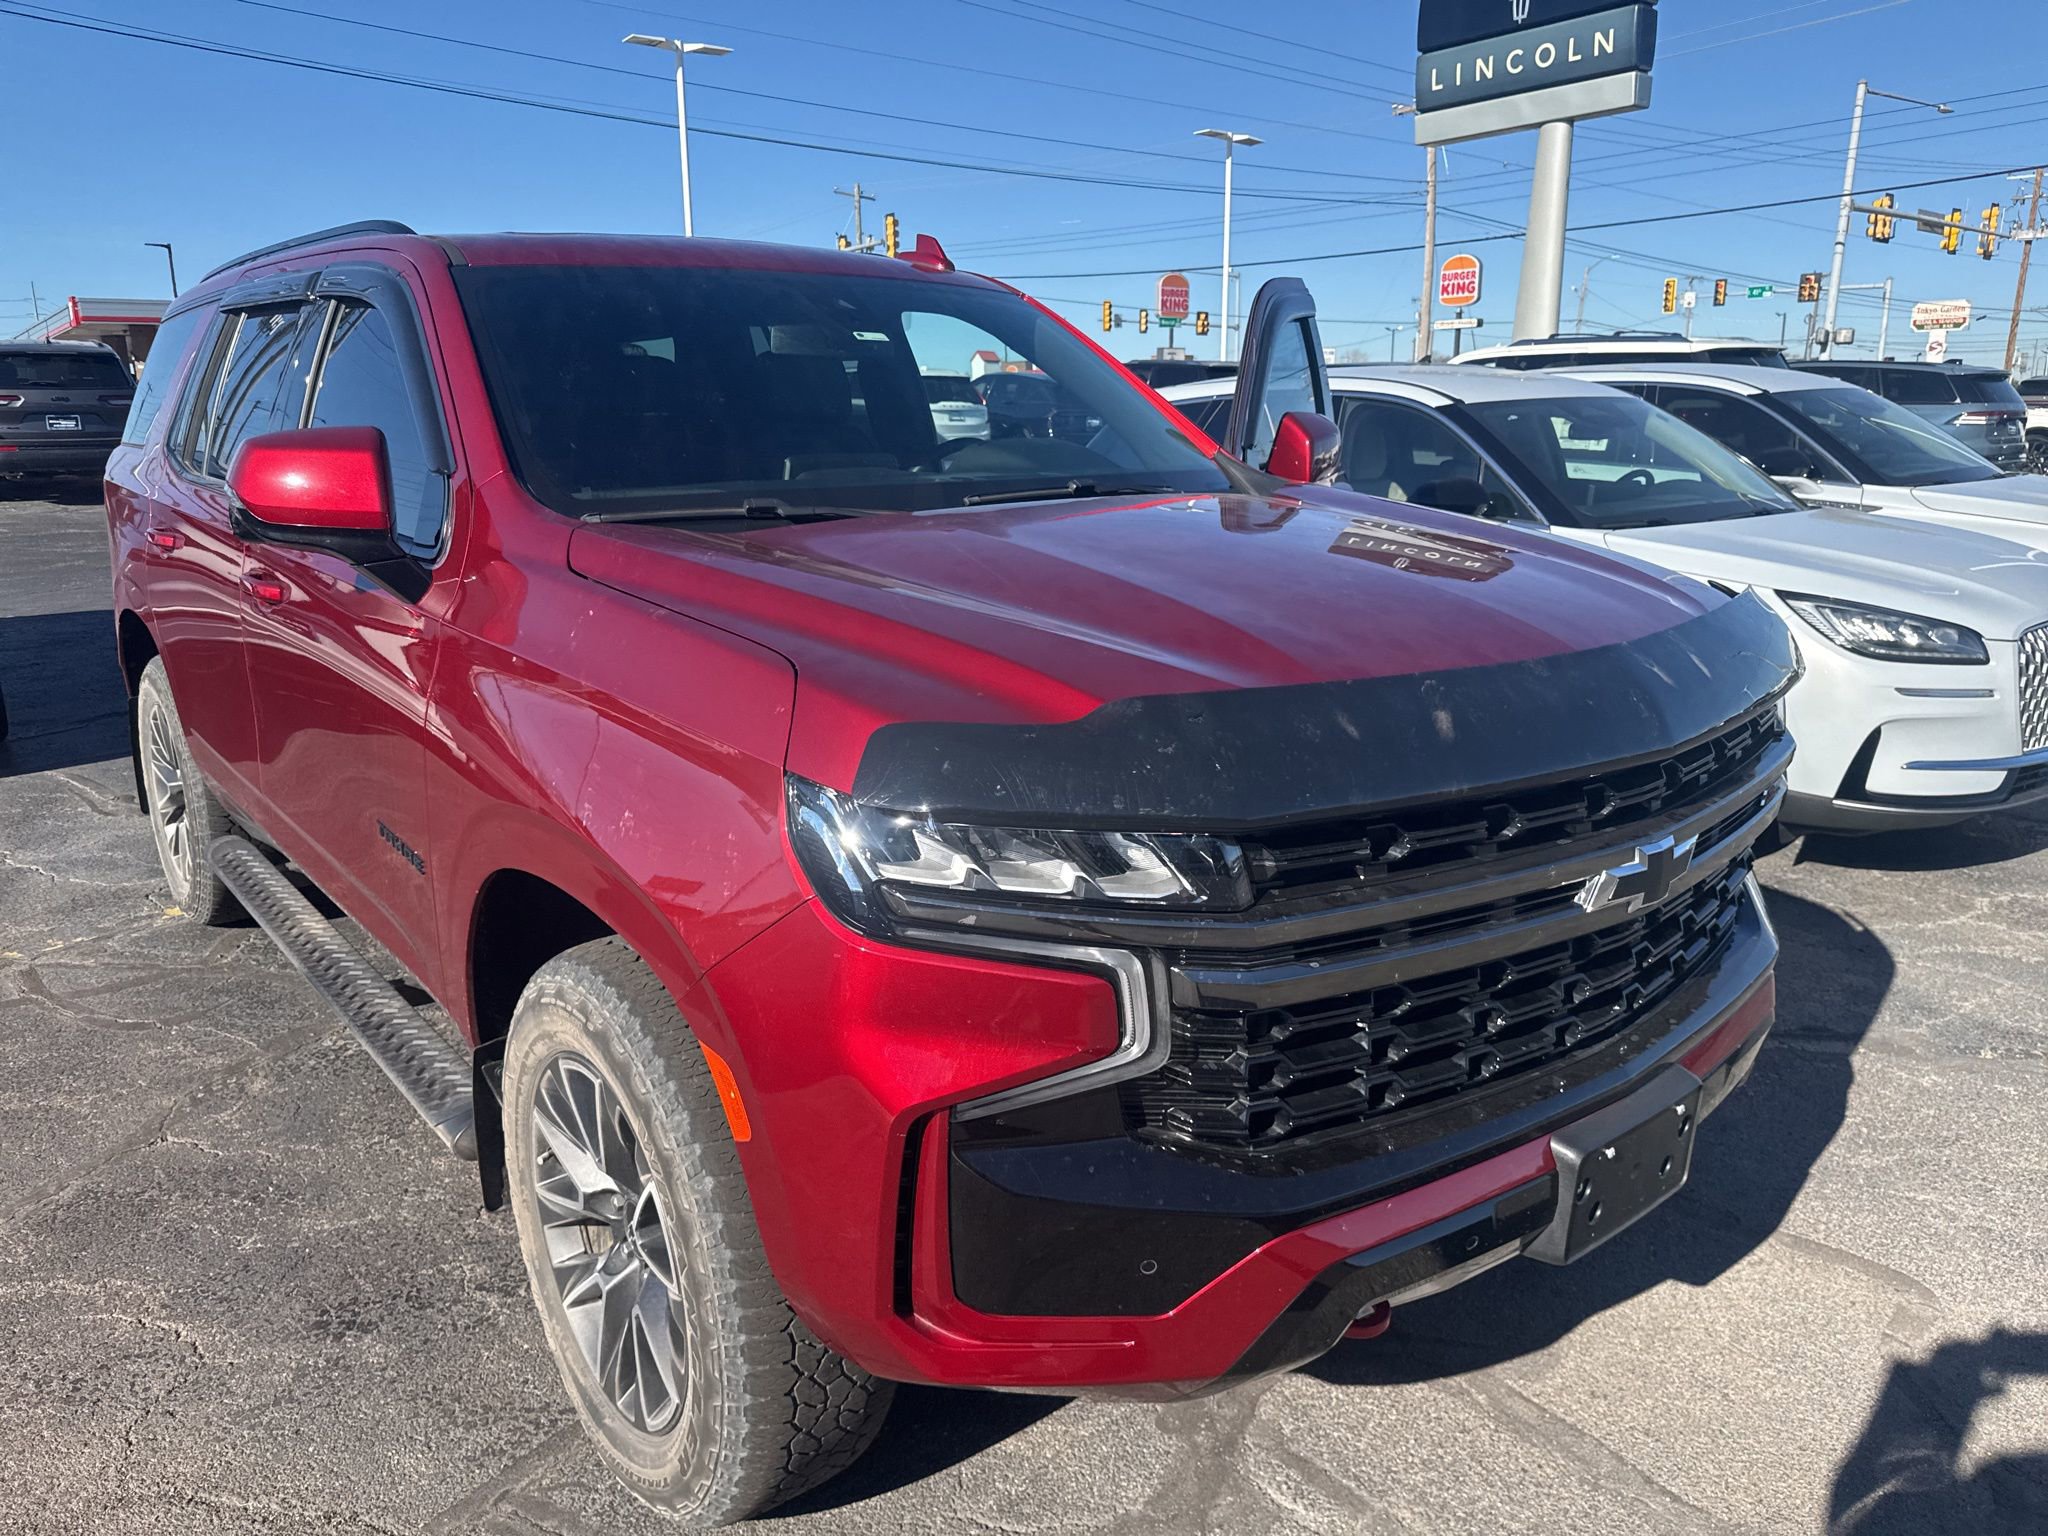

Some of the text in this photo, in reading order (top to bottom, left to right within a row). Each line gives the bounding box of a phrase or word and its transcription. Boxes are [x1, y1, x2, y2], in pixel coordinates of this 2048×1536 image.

[1431, 28, 1615, 91] LINCOLN
[1441, 270, 1477, 282] BURGER
[1440, 281, 1476, 296] KING
[1161, 298, 1189, 312] KING
[1916, 305, 1966, 315] Tokyo Garden
